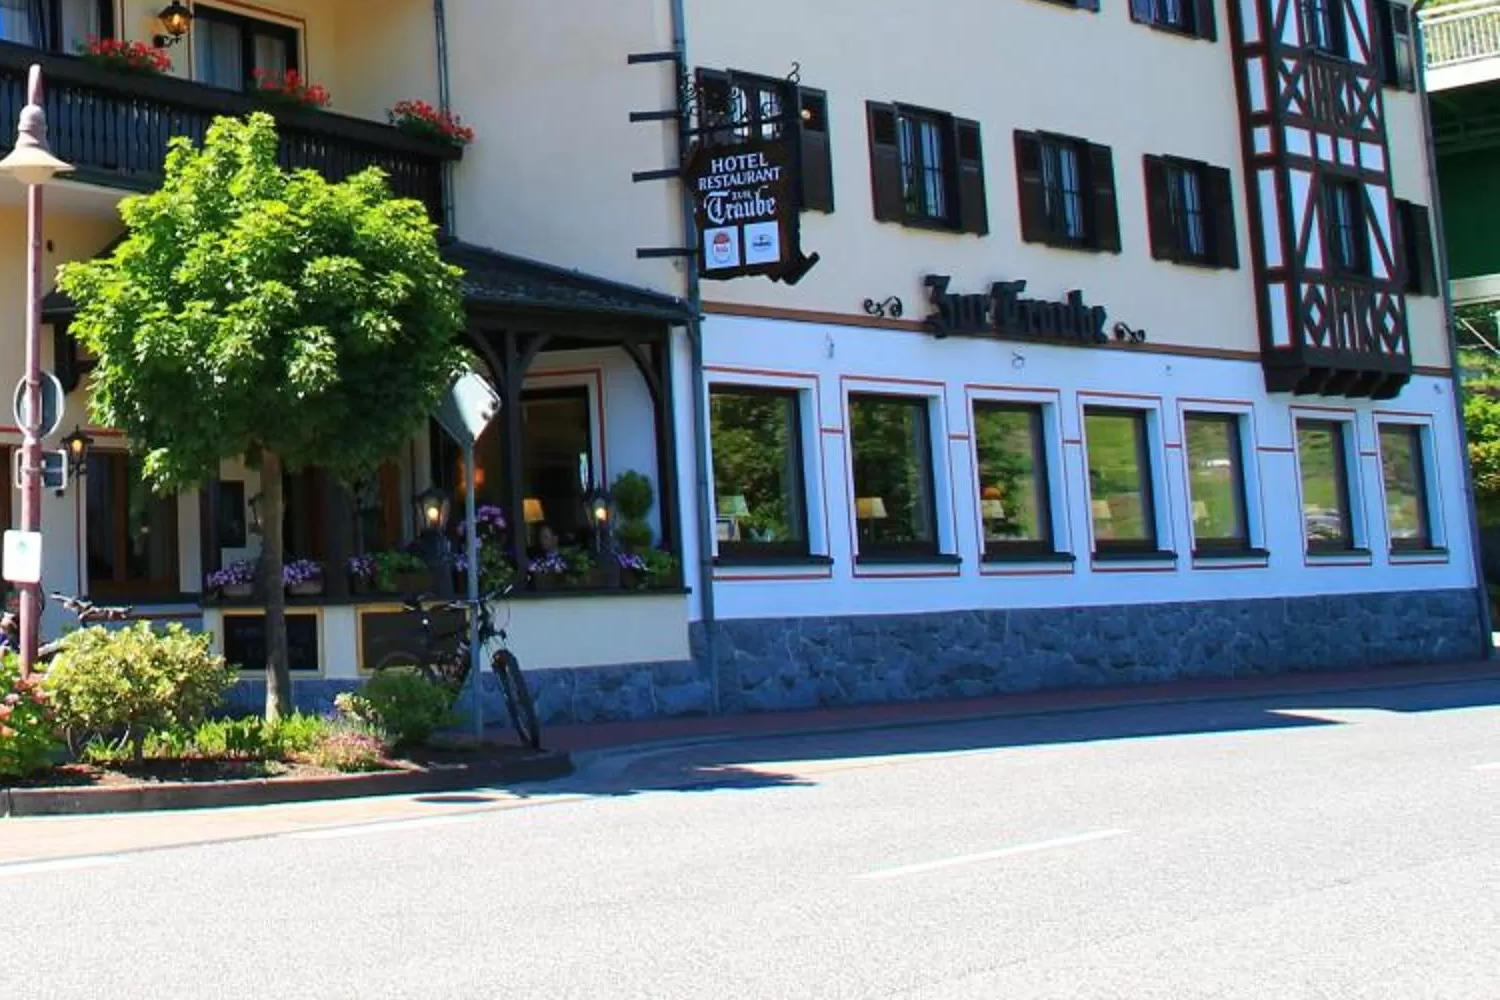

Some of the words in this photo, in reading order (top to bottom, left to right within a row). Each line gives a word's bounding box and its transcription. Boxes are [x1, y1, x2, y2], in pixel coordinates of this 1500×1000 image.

[698, 167, 782, 190] RESTAURANT
[711, 152, 768, 174] HOTEL
[704, 185, 776, 224] Traube
[991, 279, 1108, 345] Traube
